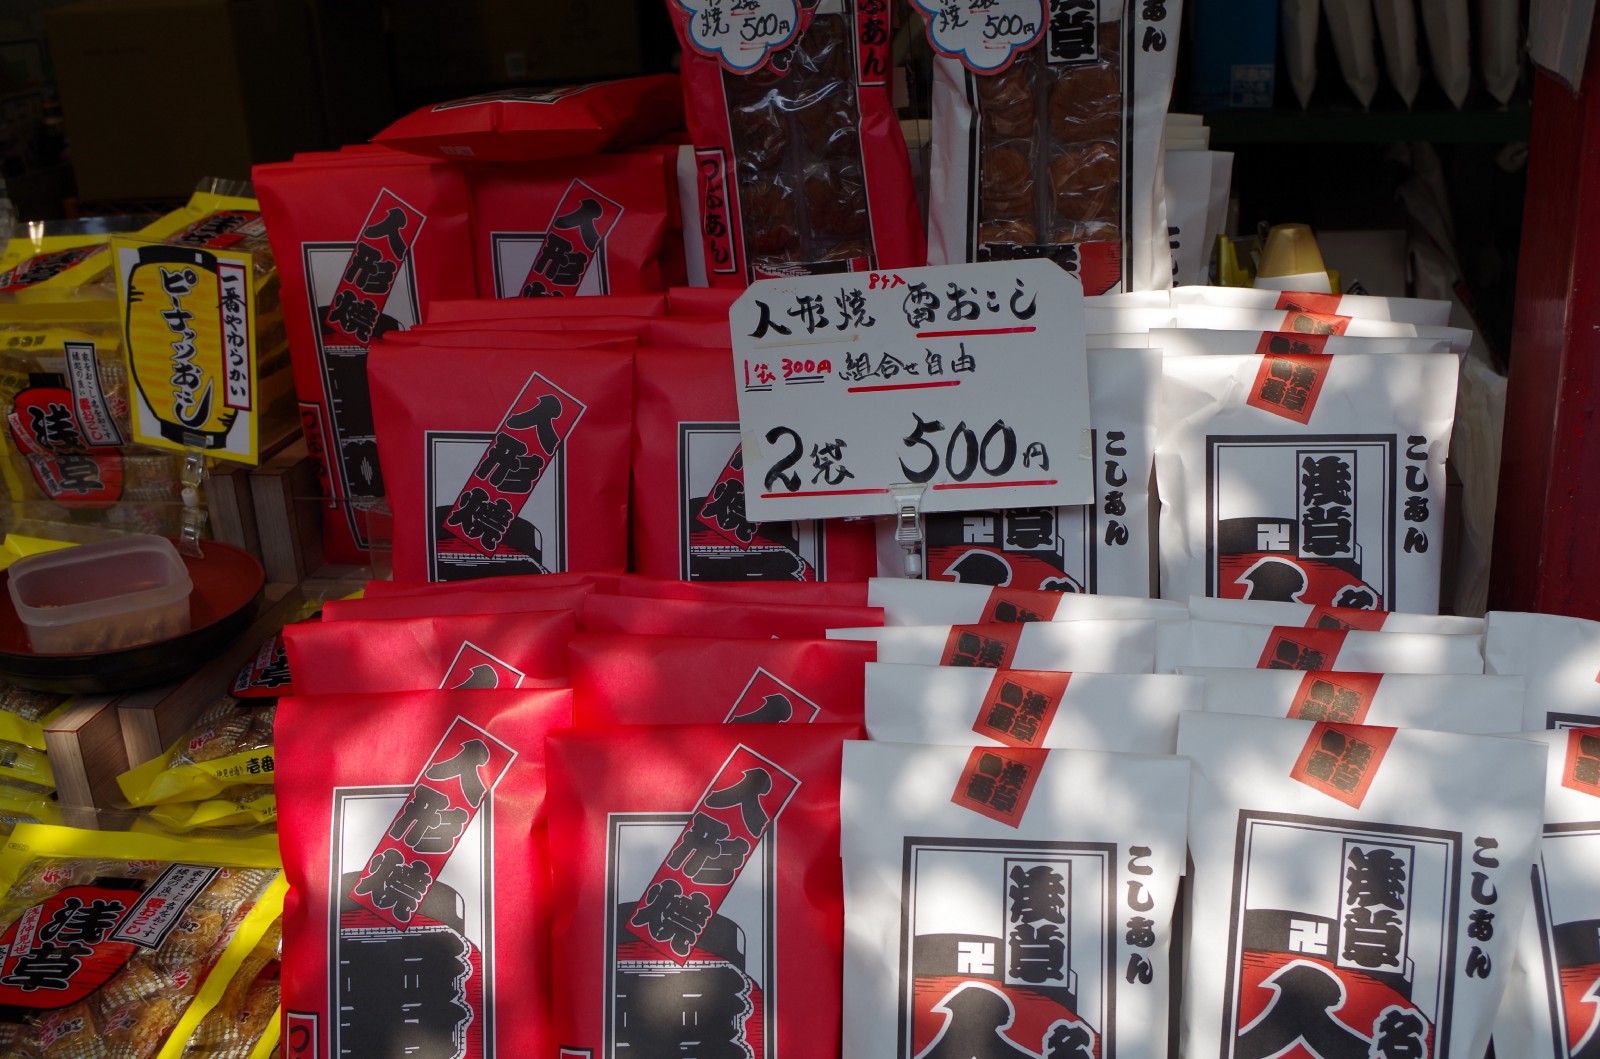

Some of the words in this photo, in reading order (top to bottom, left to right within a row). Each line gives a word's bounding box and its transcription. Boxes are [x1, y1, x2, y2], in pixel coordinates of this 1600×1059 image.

[740, 13, 790, 41] 500円
[983, 15, 1036, 39] 500円
[1049, 0, 1096, 59] 草
[701, 158, 730, 264] つぶあん
[160, 265, 215, 429] ピーナッツおこし
[219, 274, 248, 397] 一番やわらかい
[743, 359, 777, 385] 1袋
[781, 357, 833, 377] 300円
[838, 342, 977, 384] 組合せ自由
[748, 288, 876, 339] 人形焼
[901, 277, 1038, 329] 雷おこし
[764, 425, 855, 493] 2袋
[898, 411, 1050, 484] 500円
[1103, 430, 1130, 547] こしあん
[1402, 435, 1430, 555] こしあん
[353, 738, 492, 923] 人形焼
[630, 766, 774, 957] 人形焼
[1, 897, 126, 991] 浅草
[1125, 845, 1156, 985] こしあん
[1465, 836, 1500, 980] こしあん
